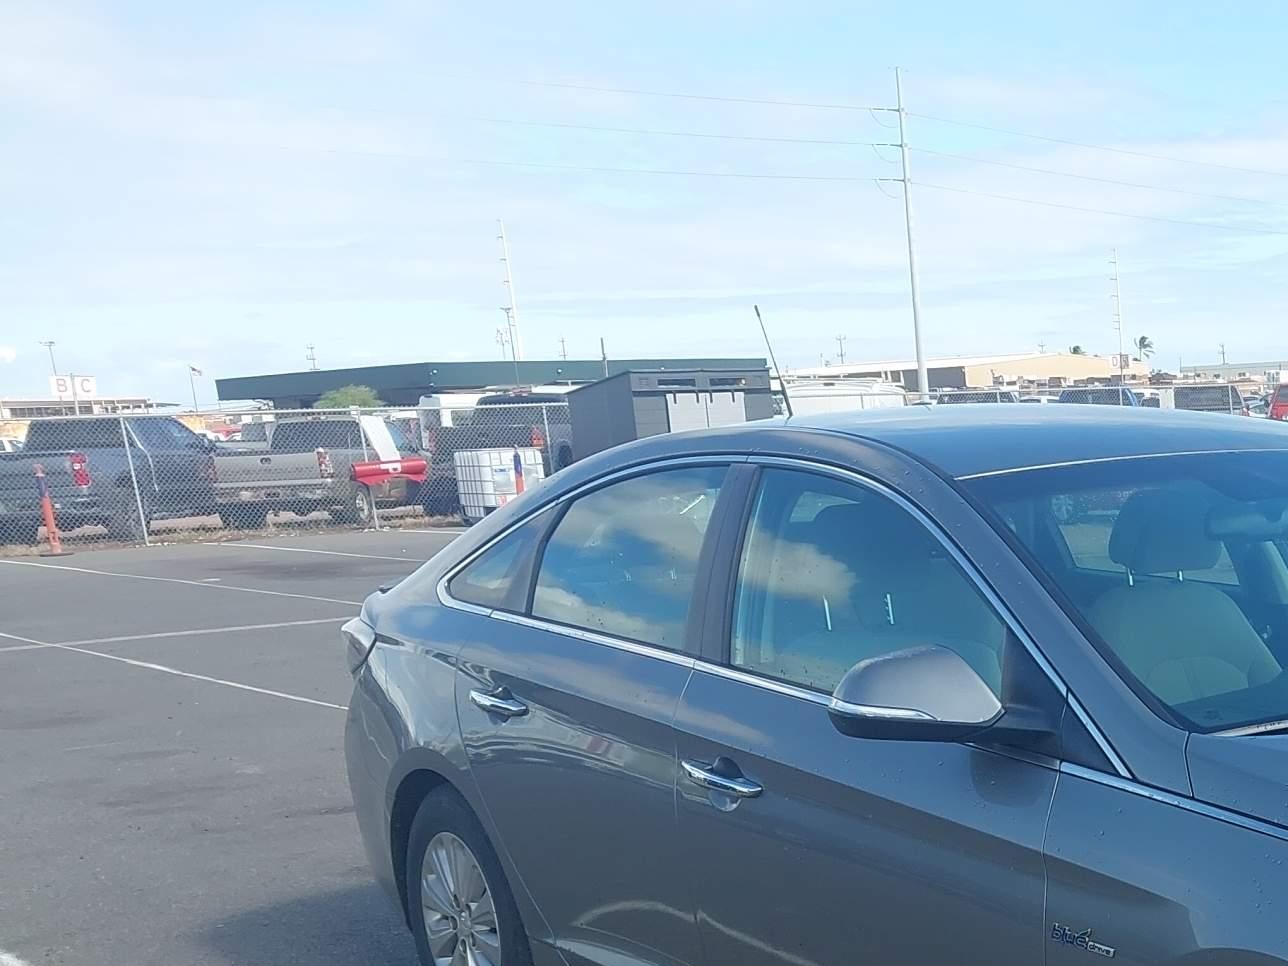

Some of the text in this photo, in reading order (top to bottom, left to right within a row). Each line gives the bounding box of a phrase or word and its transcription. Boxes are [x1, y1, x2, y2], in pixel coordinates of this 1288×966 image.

[56, 379, 91, 392] B C
[1052, 923, 1091, 949] blue
